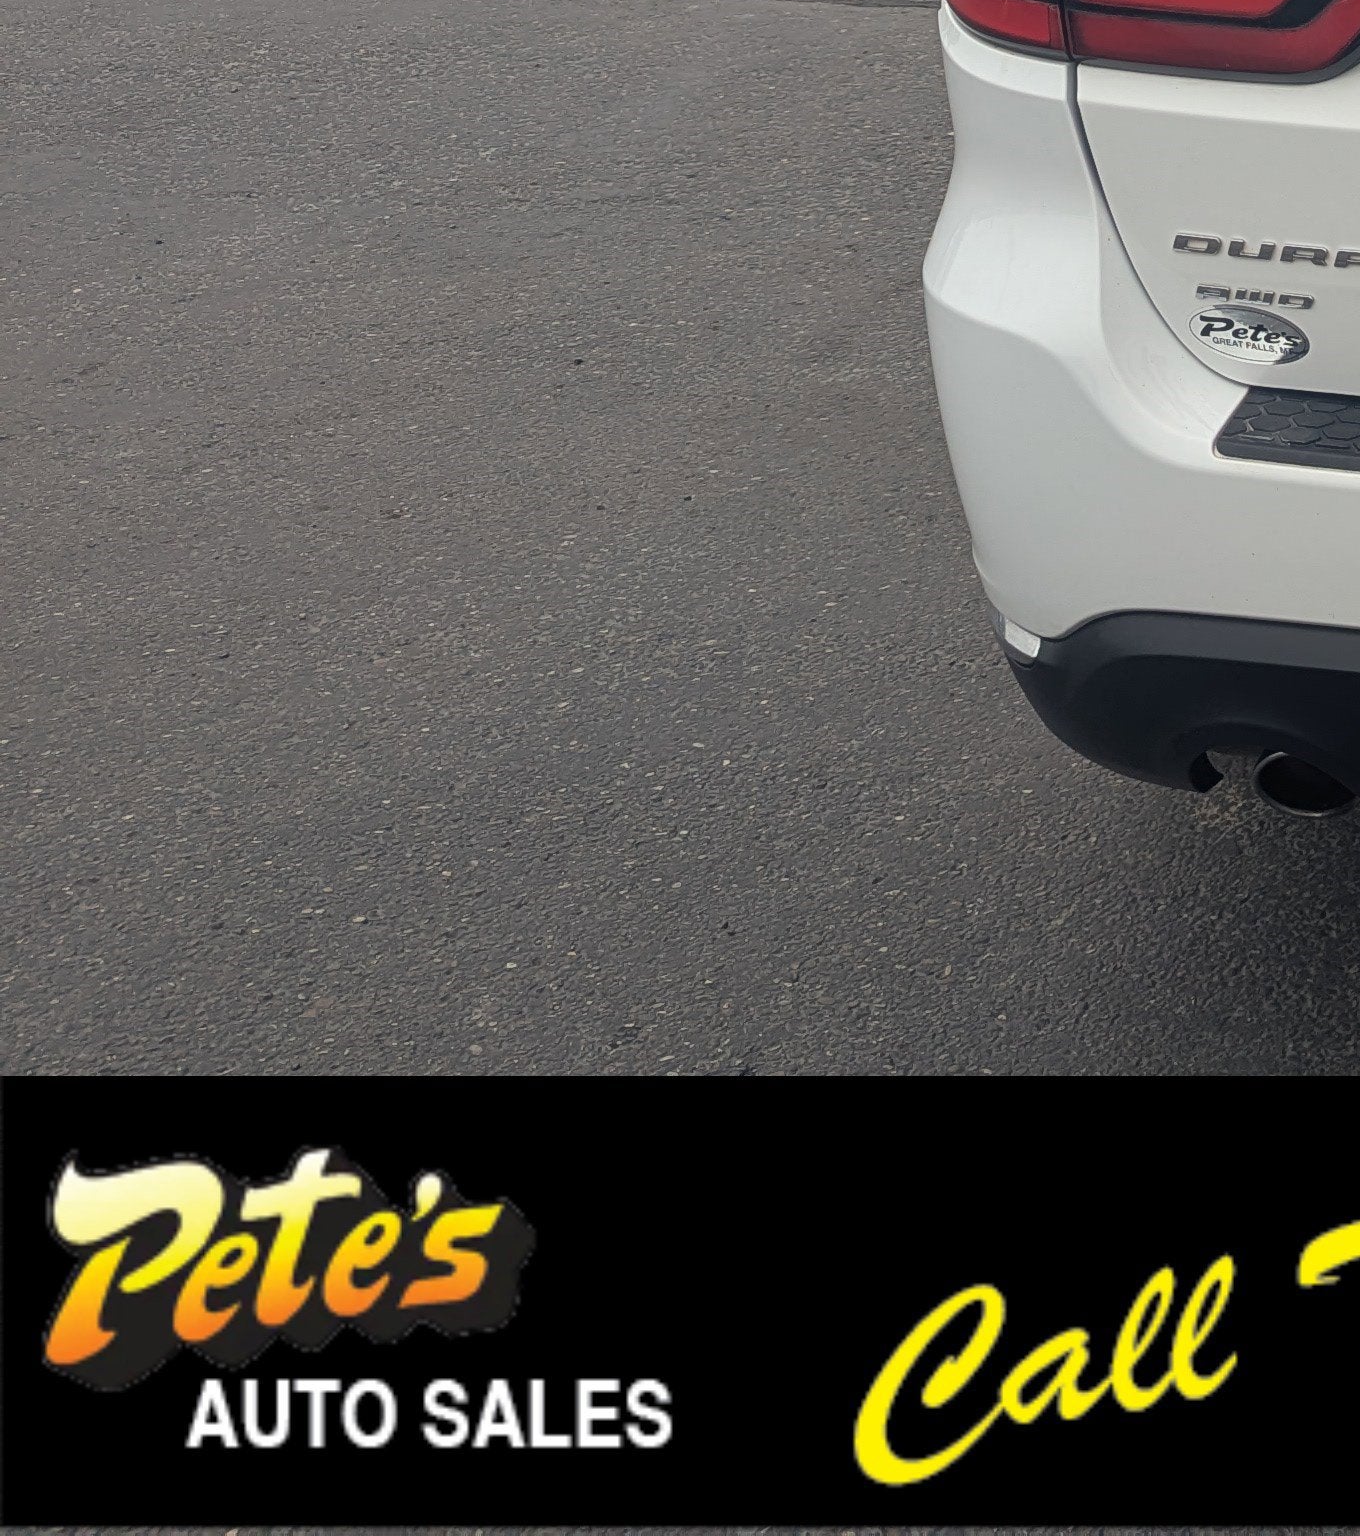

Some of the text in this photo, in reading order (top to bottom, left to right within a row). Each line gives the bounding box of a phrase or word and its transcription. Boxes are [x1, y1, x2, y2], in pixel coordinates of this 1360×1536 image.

[1196, 283, 1316, 310] AWD
[1199, 314, 1303, 347] Pete's
[1212, 336, 1244, 349] GREAT
[1245, 341, 1278, 355] FALLS,
